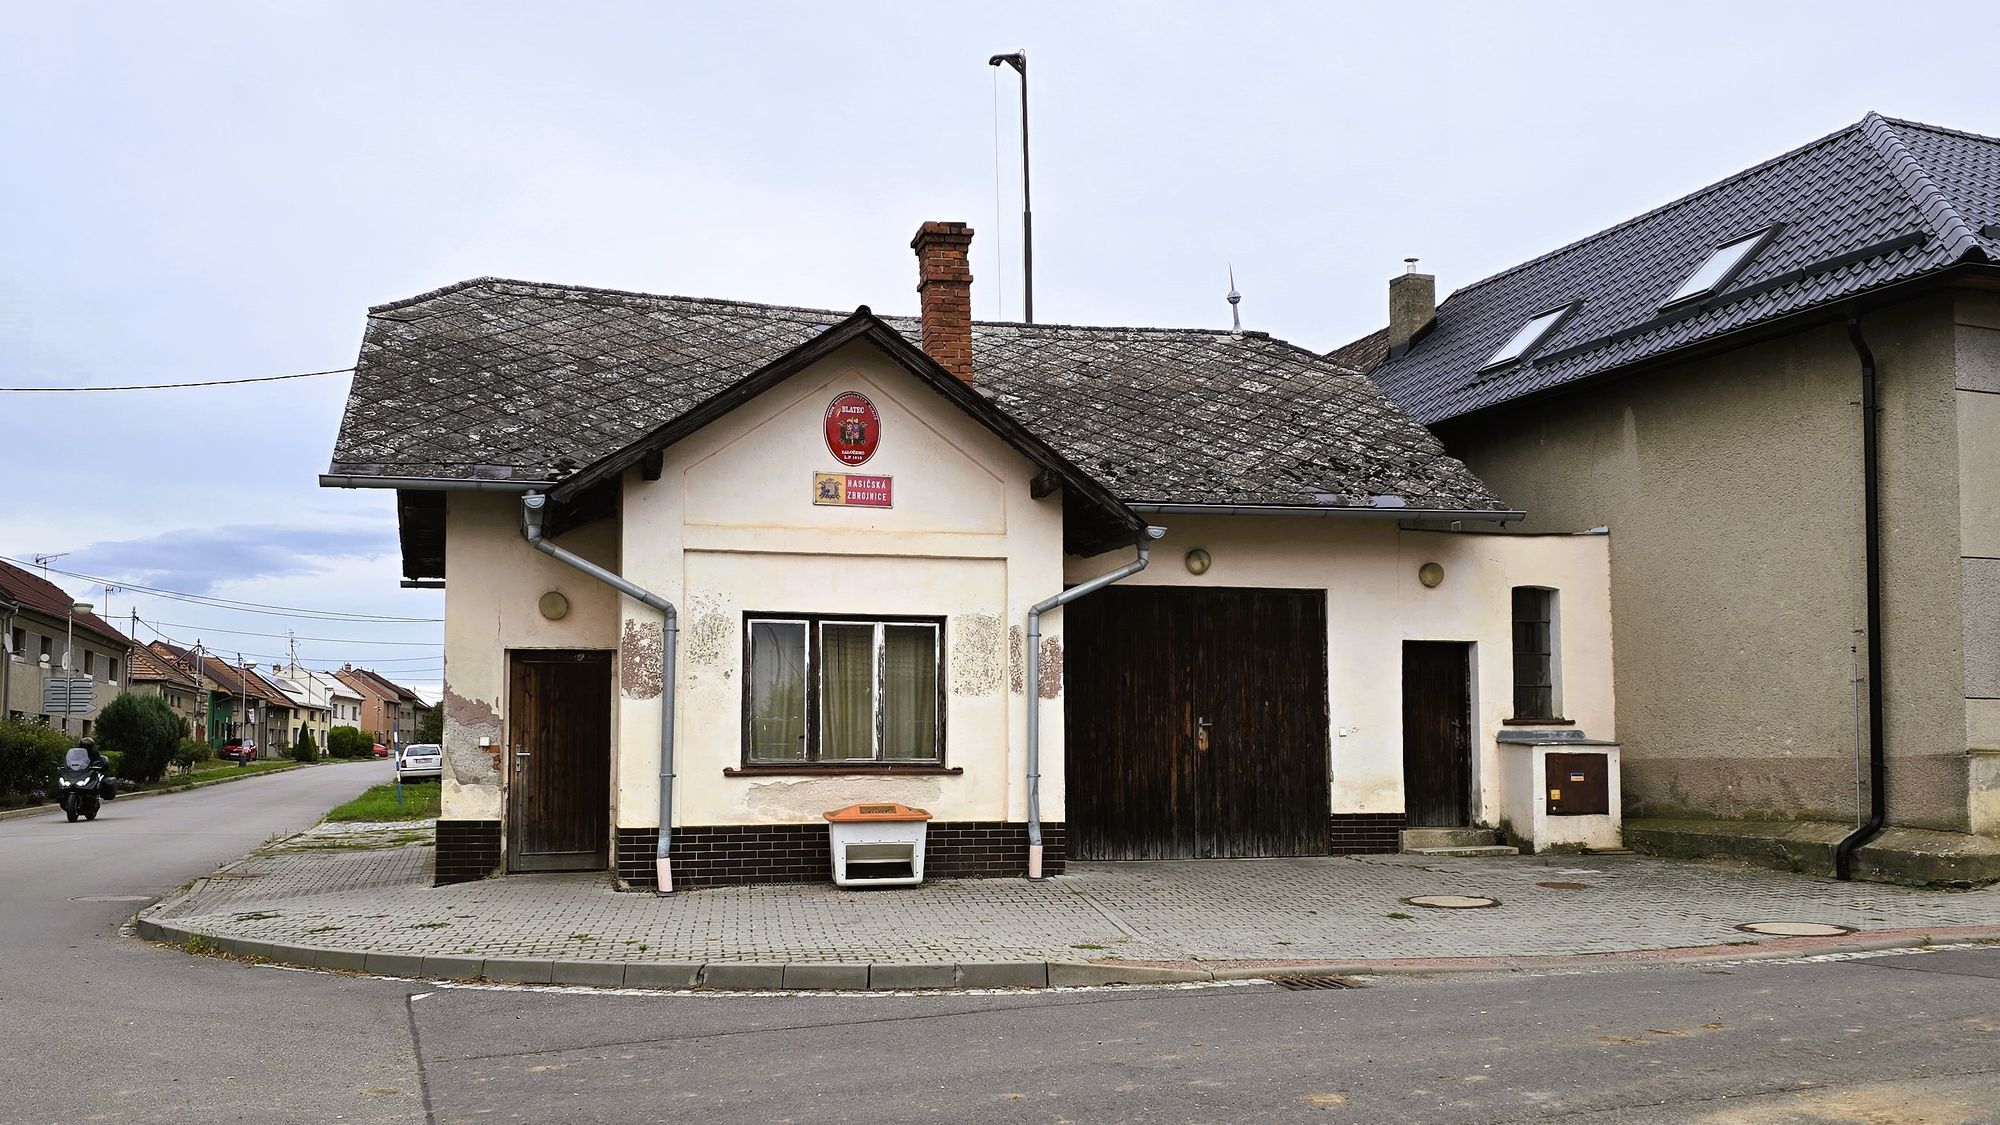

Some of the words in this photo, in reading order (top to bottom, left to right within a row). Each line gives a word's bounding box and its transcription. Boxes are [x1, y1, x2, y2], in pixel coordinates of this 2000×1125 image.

[841, 406, 865, 414] BLATEC
[847, 480, 886, 489] HASIČSKÁ
[847, 491, 887, 501] ZBROJNICE
